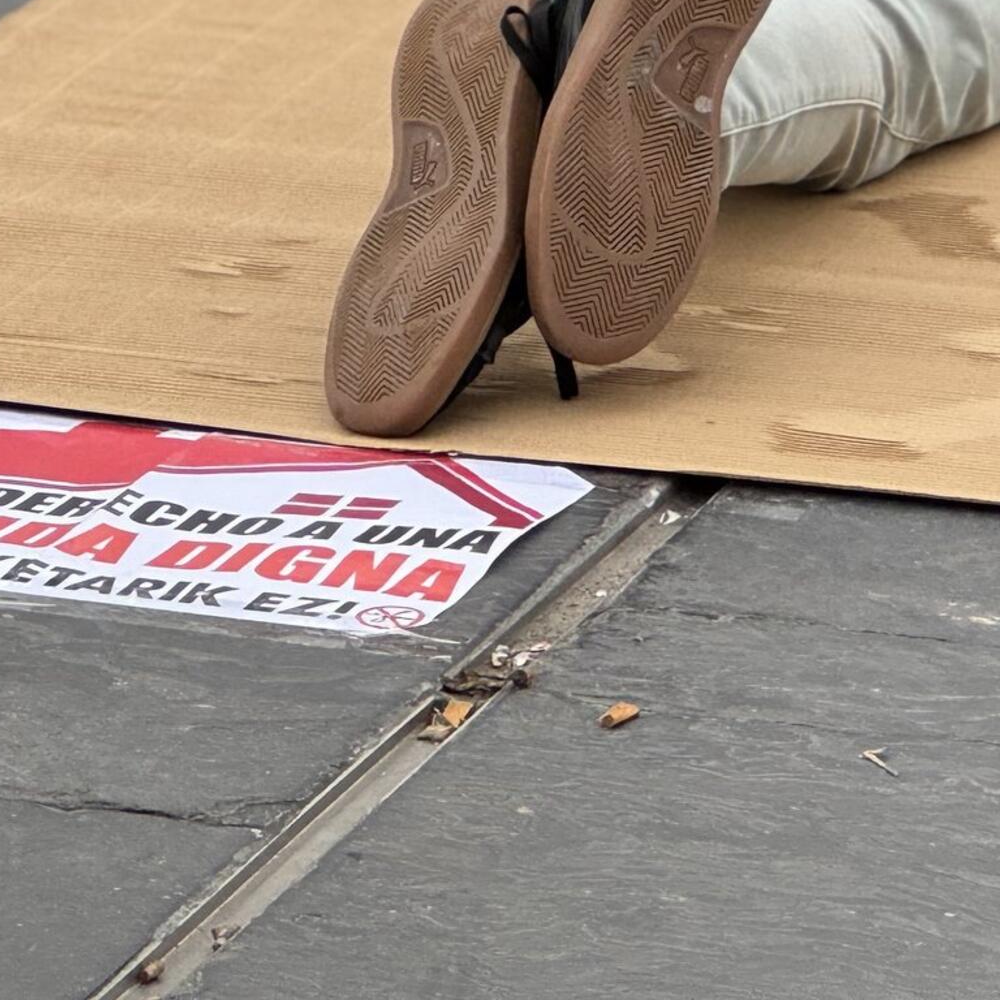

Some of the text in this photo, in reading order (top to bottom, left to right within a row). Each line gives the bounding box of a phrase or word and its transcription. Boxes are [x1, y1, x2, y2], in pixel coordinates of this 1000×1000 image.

[284, 521, 346, 541] A
[355, 525, 502, 555] UNA
[144, 539, 468, 604] DIGNA
[243, 591, 361, 622] EZ!
